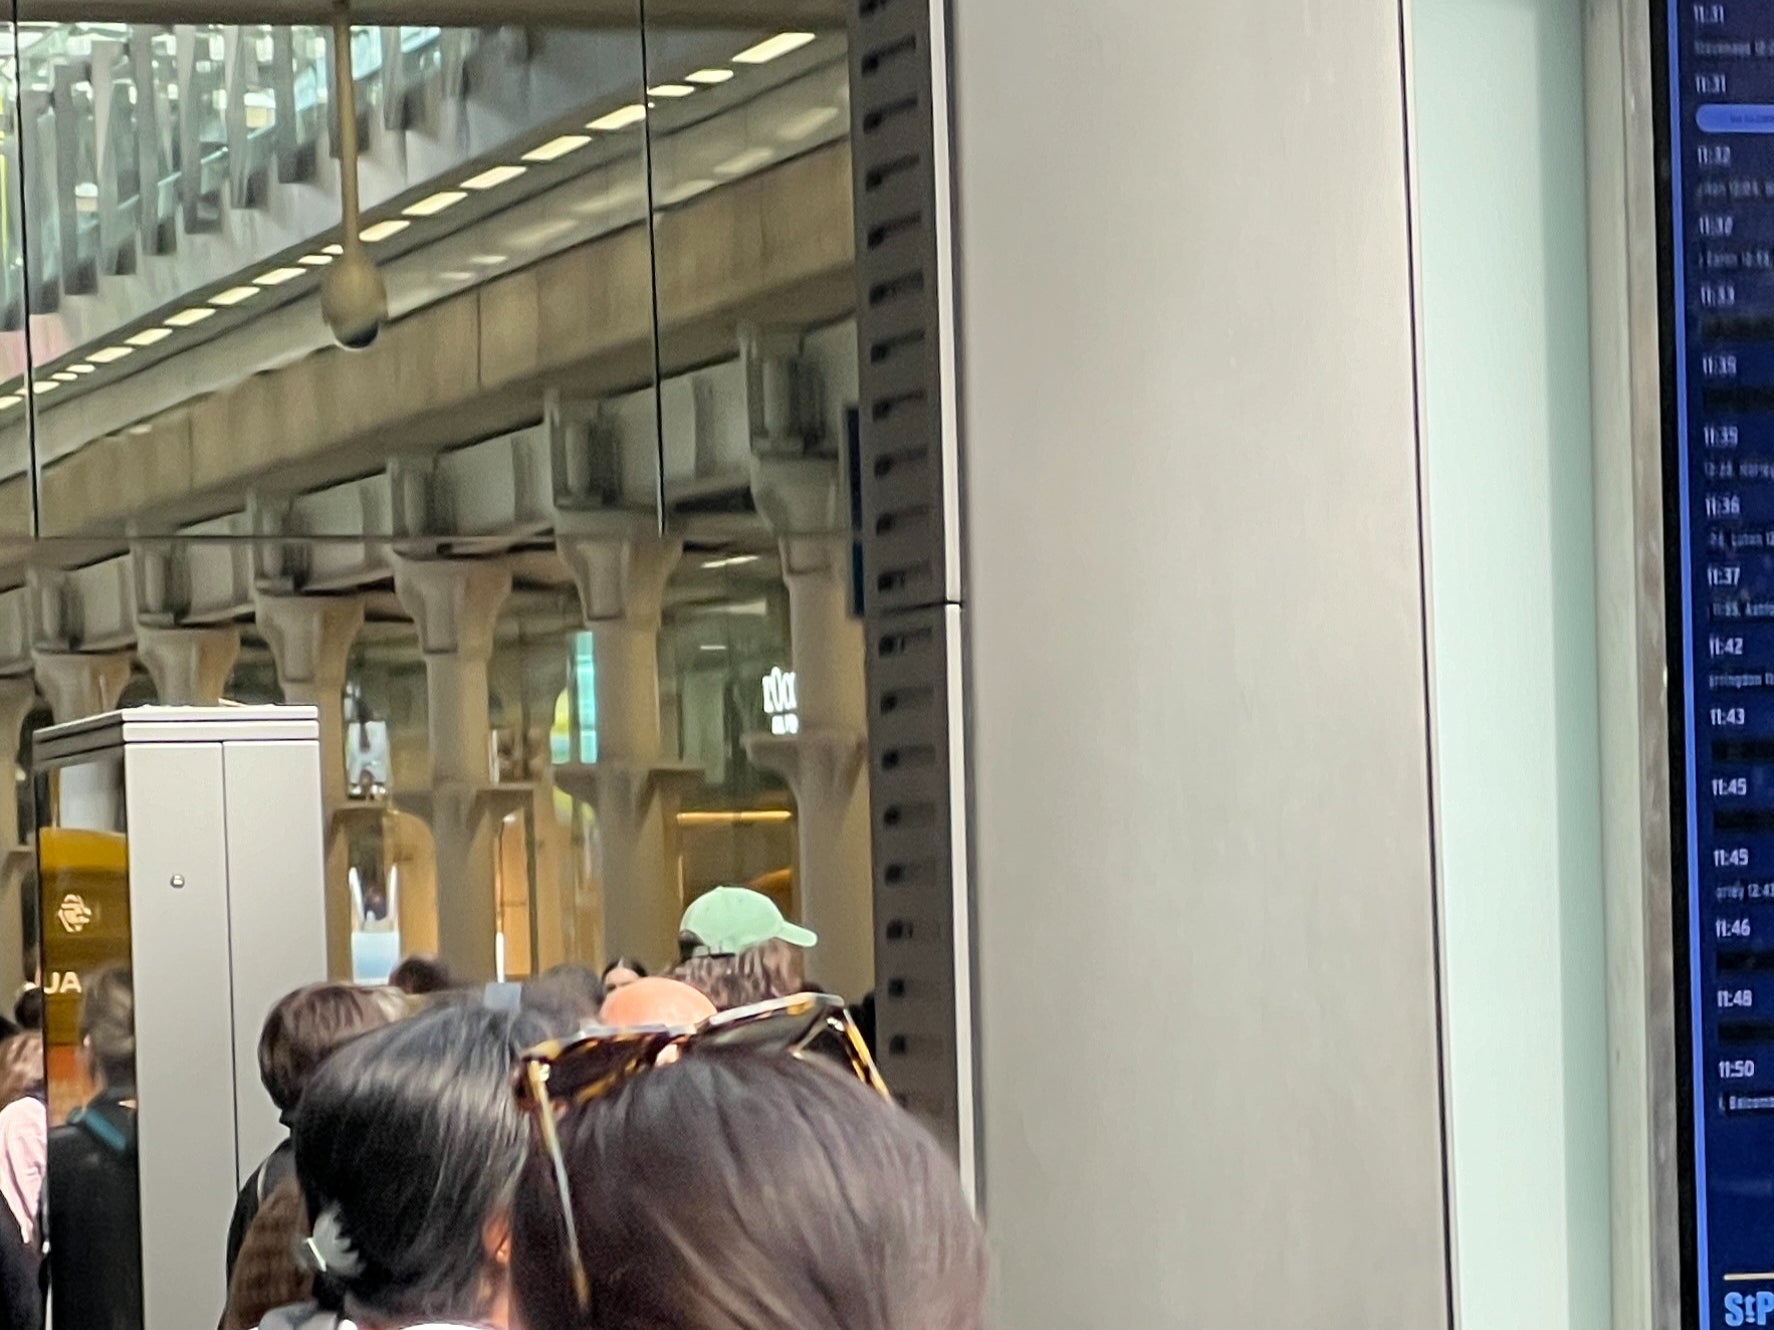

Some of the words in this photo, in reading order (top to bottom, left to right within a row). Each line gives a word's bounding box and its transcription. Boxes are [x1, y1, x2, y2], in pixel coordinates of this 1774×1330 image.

[1707, 566, 1740, 586] 11:37
[1709, 636, 1743, 656] 11:42
[1710, 707, 1745, 725] 11:43
[1712, 778, 1747, 796] 11:45
[1714, 848, 1748, 866] 11:45
[1716, 918, 1750, 937] 11:46
[1717, 989, 1752, 1007] 11:48
[1719, 1060, 1755, 1078] 11:50
